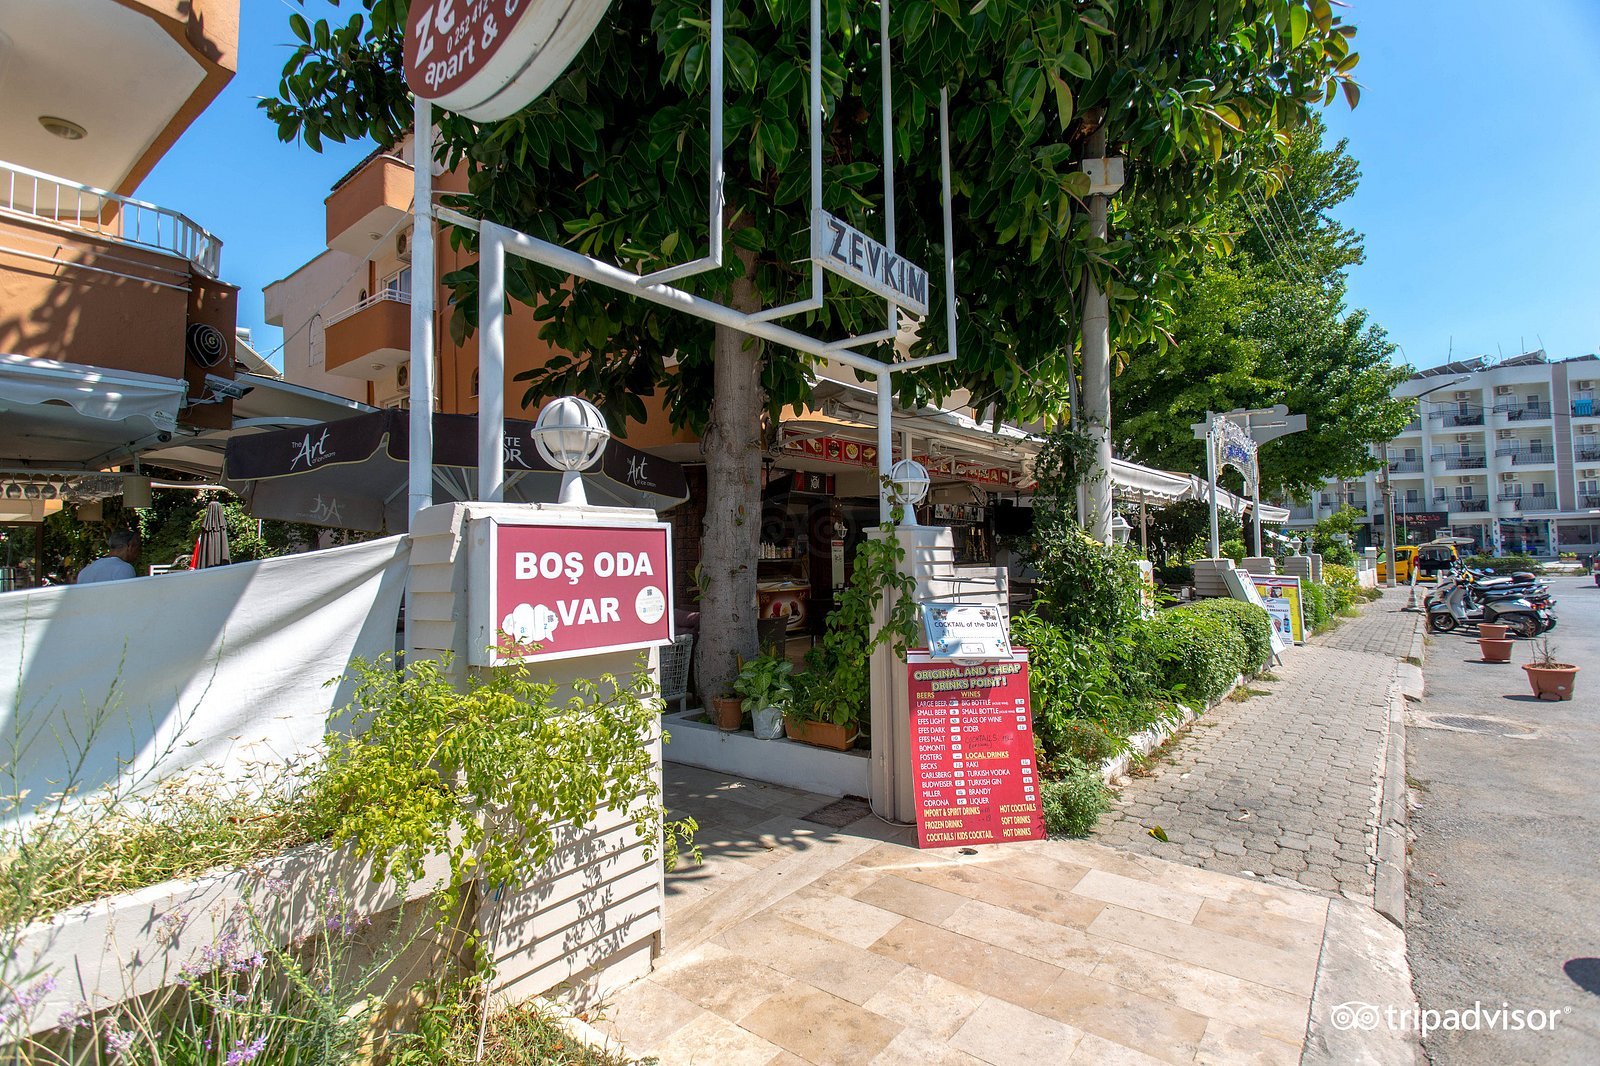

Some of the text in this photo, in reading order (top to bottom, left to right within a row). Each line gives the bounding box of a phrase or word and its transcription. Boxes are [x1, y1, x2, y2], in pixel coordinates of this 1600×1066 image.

[425, 35, 476, 91] apart
[481, 13, 499, 50] &
[827, 219, 926, 305] ZEVKIM
[290, 428, 330, 471] Art
[626, 455, 648, 486] Art
[515, 551, 654, 585] BOŞ ODA
[556, 597, 621, 626] VAR
[914, 664, 1021, 680] ORIGINAL AND CHEAP
[931, 679, 969, 692] DRINKS
[921, 771, 952, 779] CARLSBERG
[924, 808, 942, 817] IMPORT
[948, 807, 961, 816] SPIRIT
[963, 806, 980, 815] DRINKS
[1000, 804, 1010, 813] HOT
[1011, 803, 1036, 812] COCKTAILS
[925, 820, 962, 830] FROZEN DRINKS
[1001, 816, 1030, 825] SOFT DRINKS
[926, 832, 953, 842] COCKTAILS
[957, 831, 968, 840] KIDS
[969, 830, 993, 839] COCKTAIL
[1003, 828, 1031, 837] HOT DRINKS
